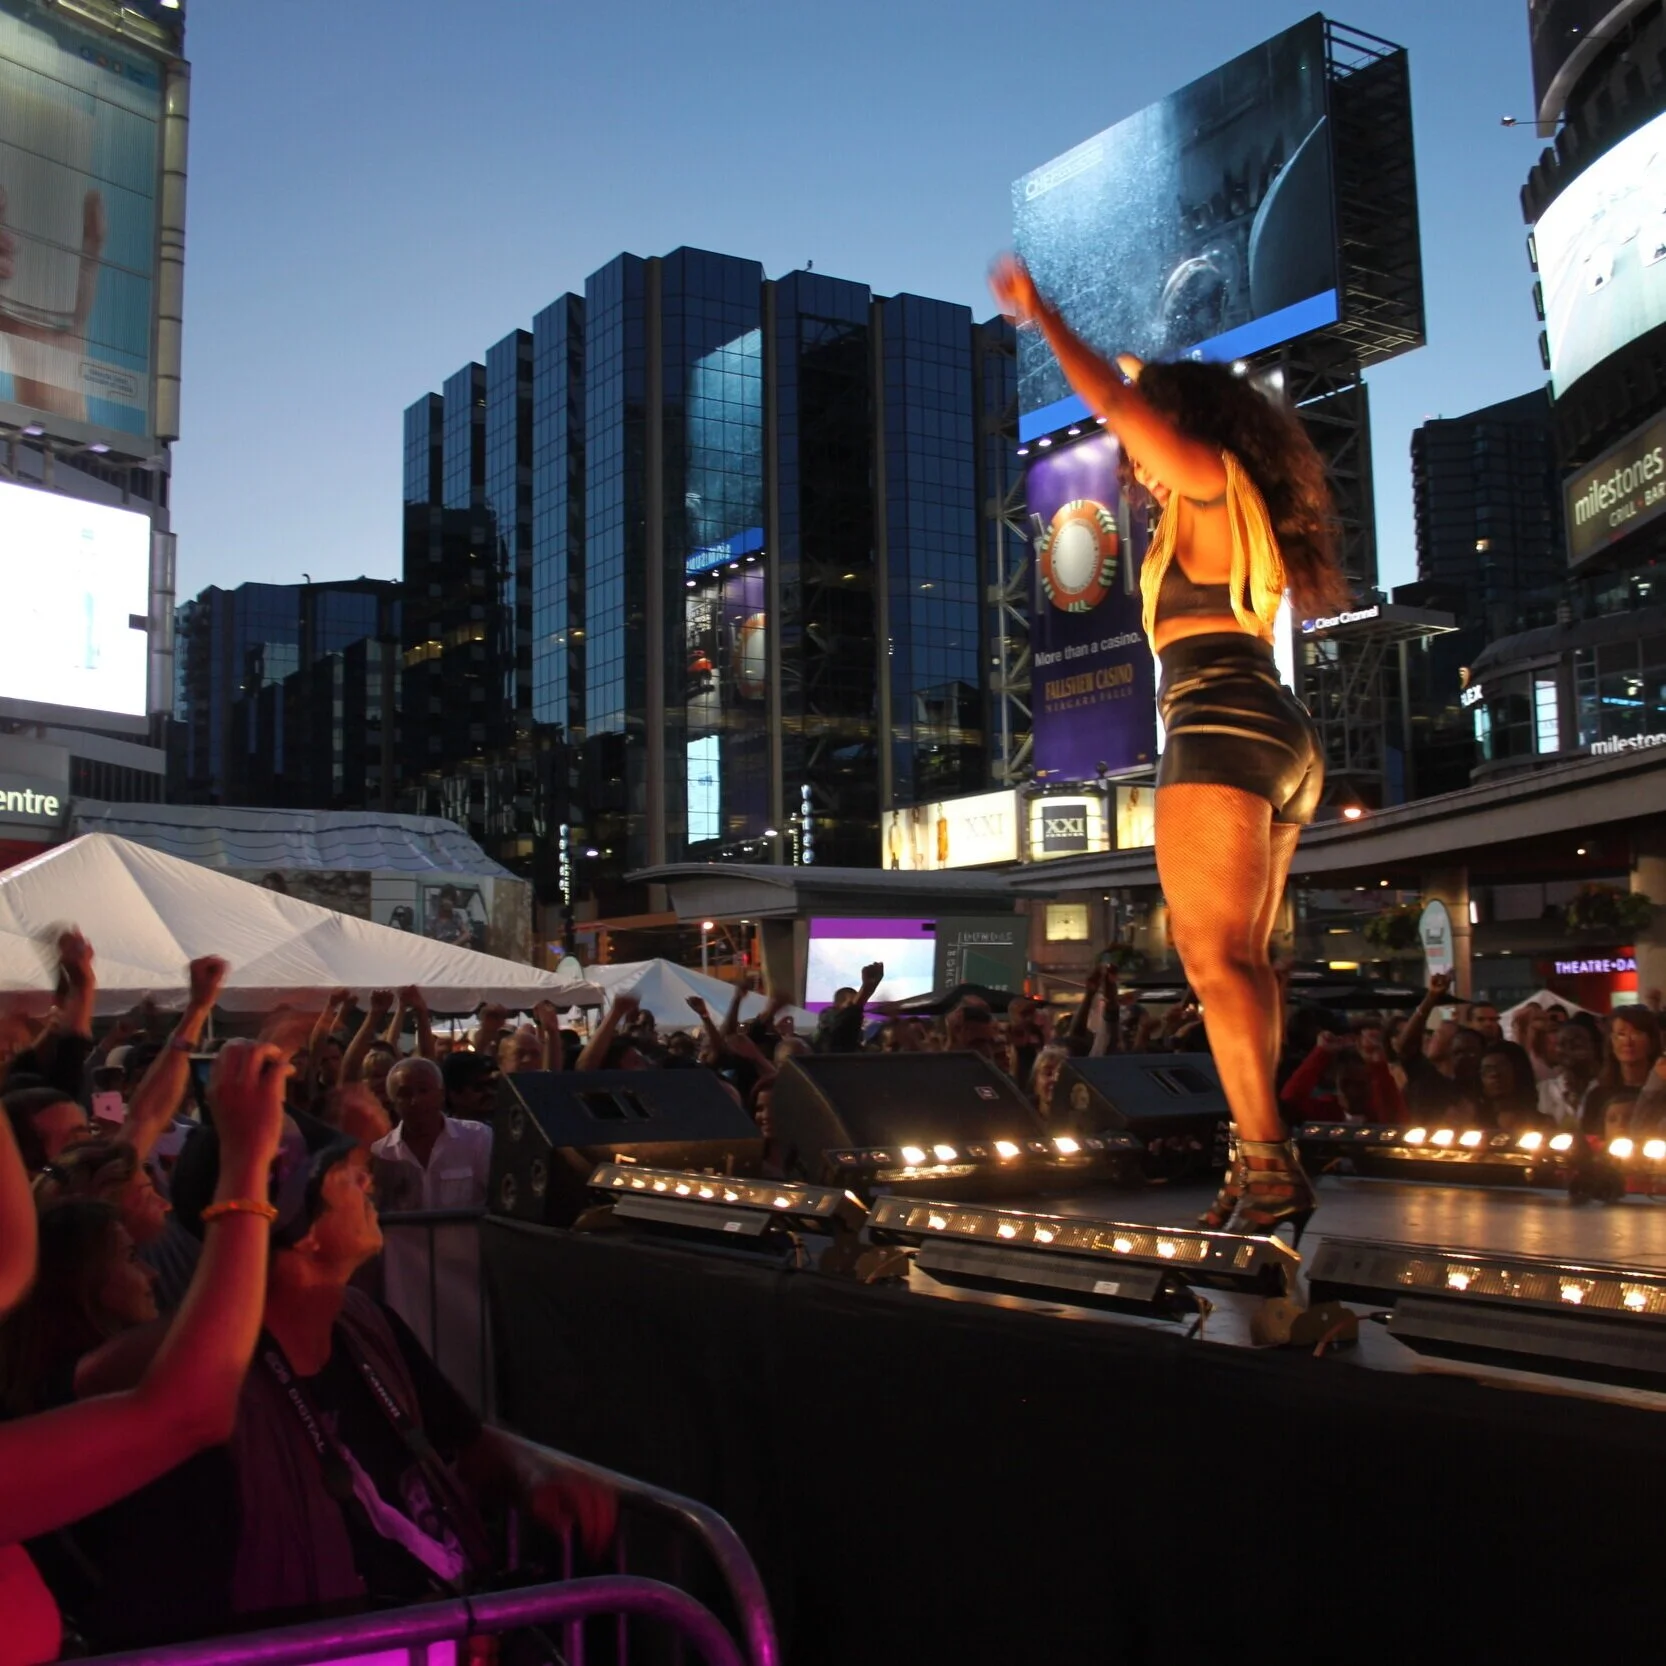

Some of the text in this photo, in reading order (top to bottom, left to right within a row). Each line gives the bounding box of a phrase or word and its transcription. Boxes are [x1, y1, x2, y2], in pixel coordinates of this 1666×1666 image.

[1575, 446, 1664, 526] milestones
[1609, 501, 1637, 527] GRILL
[1315, 605, 1379, 630] Clear Channel
[1034, 631, 1142, 668] More than a casino.
[1096, 662, 1134, 690] CASINO
[1044, 817, 1085, 834] XXI
[1554, 958, 1611, 975] THEATRE
[362, 1362, 401, 1418] Canon
[288, 1387, 326, 1455] DIGITAL
